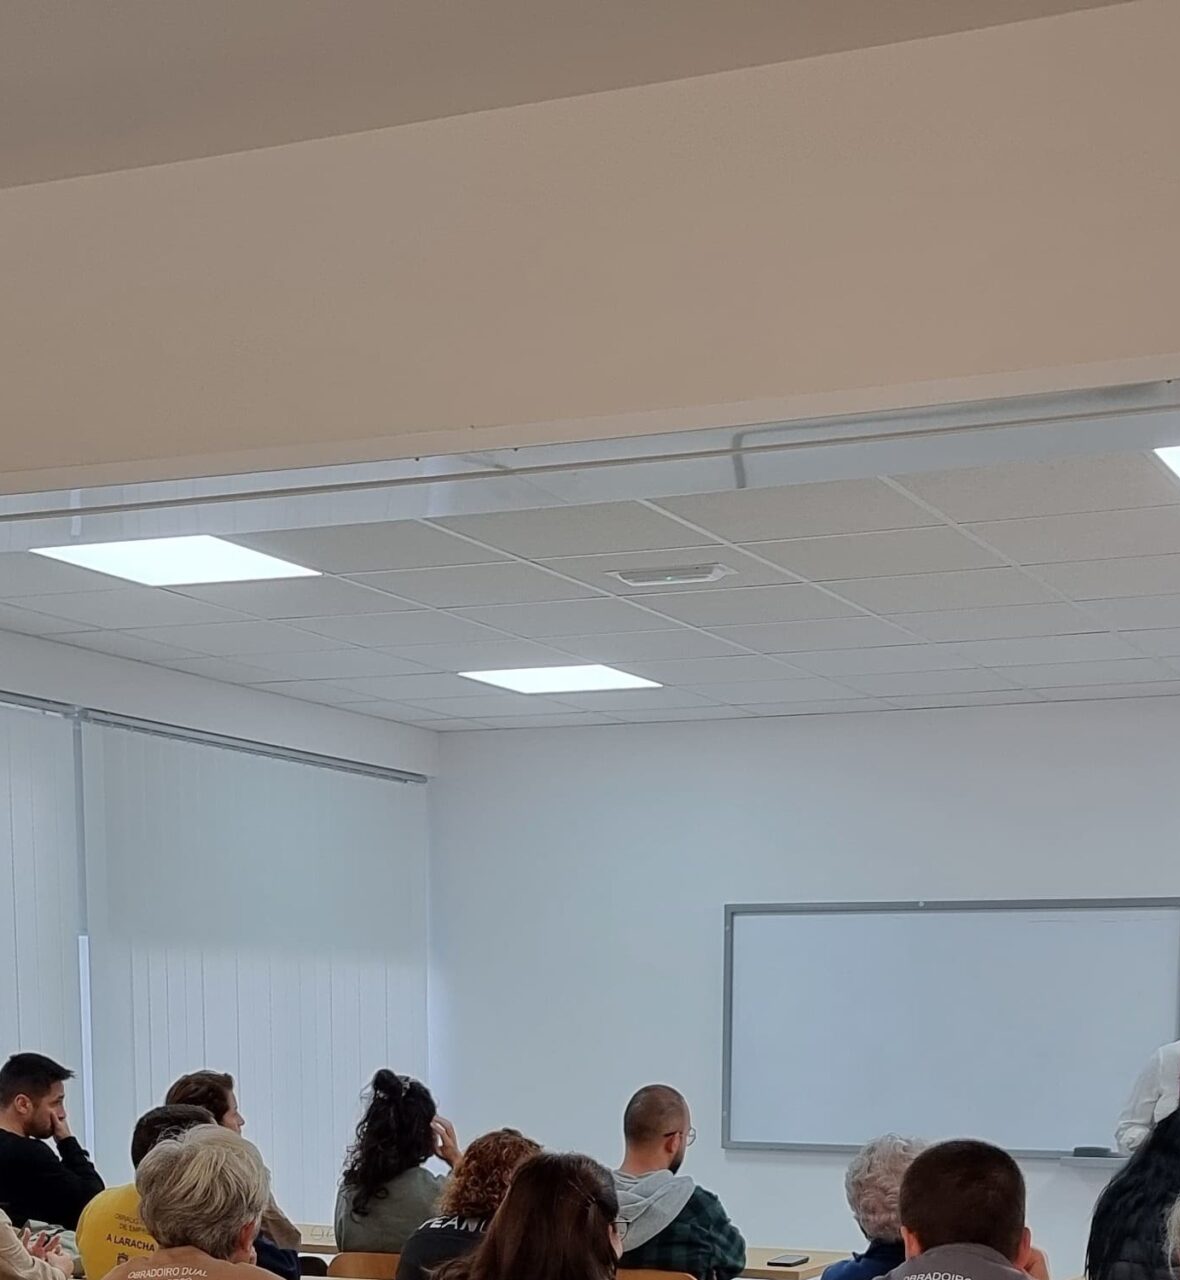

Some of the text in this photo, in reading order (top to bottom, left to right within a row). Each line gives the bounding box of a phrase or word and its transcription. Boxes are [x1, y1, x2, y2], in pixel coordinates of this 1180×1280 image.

[106, 1233, 155, 1252] A LARACHA
[127, 1267, 208, 1279] OBRADOIRO DUAL
